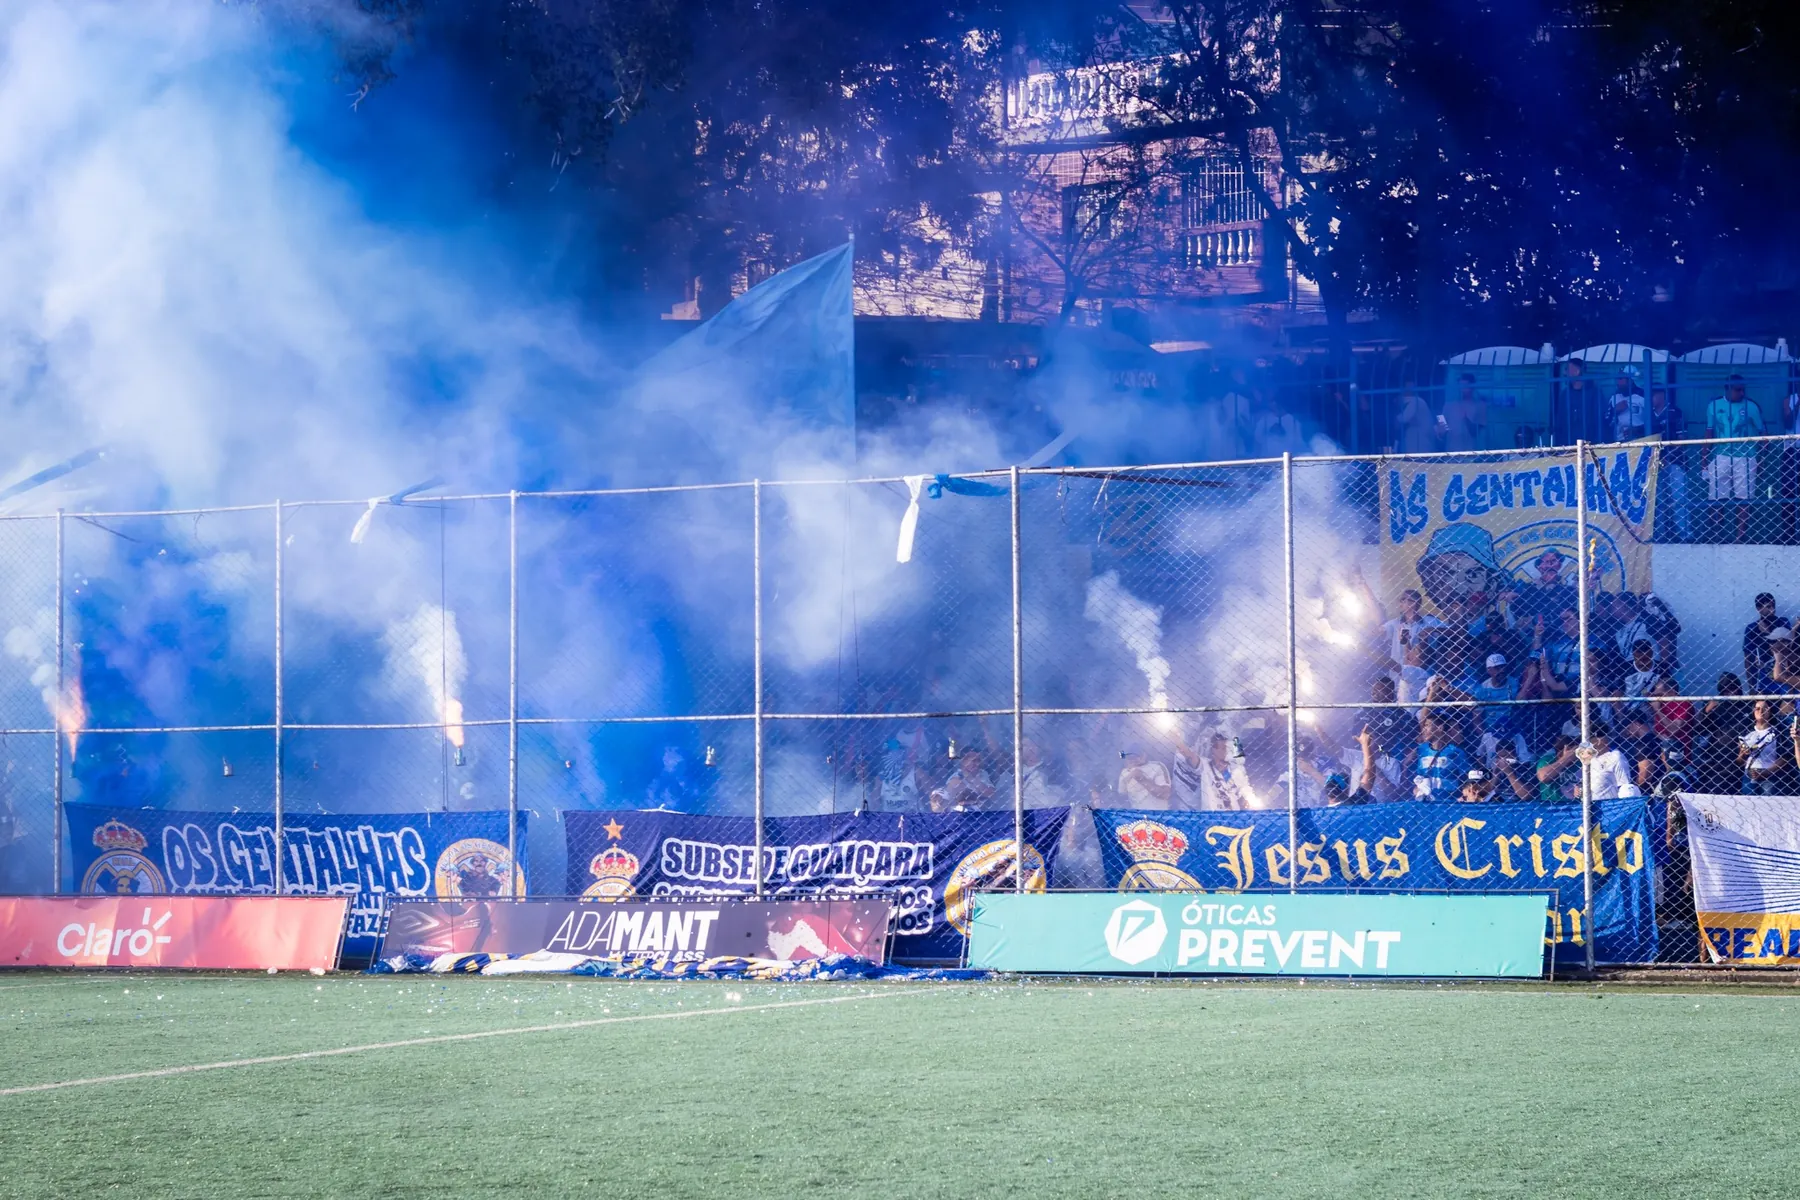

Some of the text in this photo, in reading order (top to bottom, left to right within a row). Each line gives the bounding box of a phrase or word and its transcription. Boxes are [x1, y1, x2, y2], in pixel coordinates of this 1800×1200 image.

[1388, 445, 1654, 544] OS GENTALHAS
[162, 822, 431, 893] OS GENTALHAS
[1205, 817, 1644, 893] Jesus Cristo
[546, 910, 719, 951] ADAMANT
[1181, 900, 1276, 926] ÓTICAS
[57, 922, 154, 957] Claro
[1177, 929, 1401, 969] PREVENT
